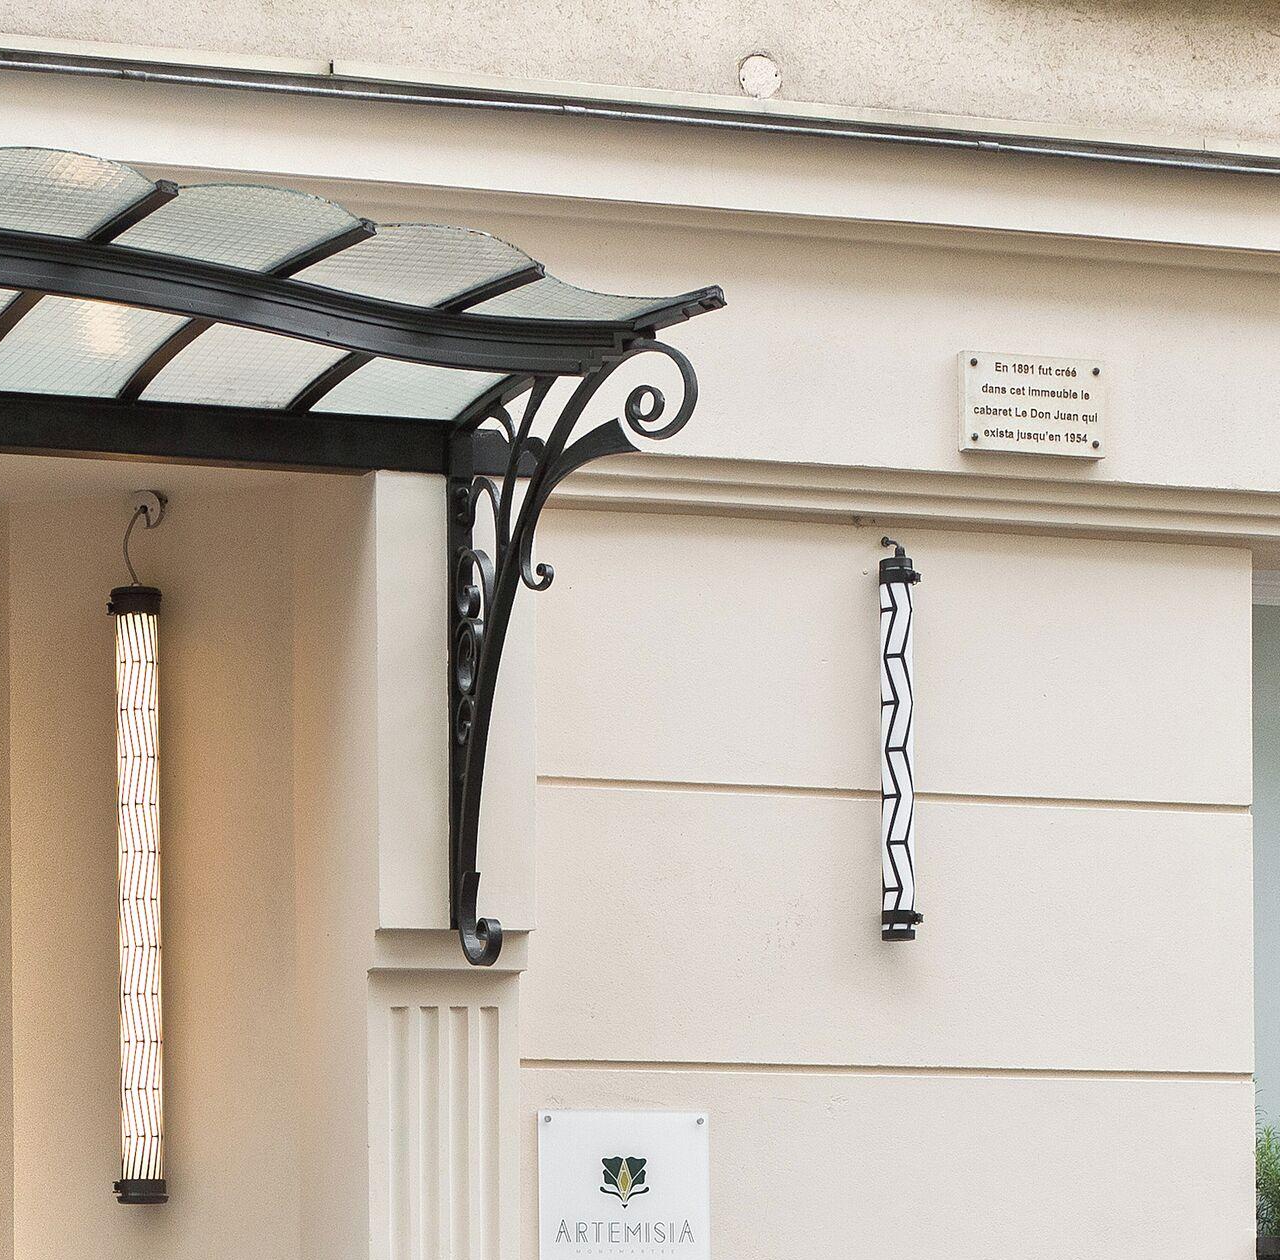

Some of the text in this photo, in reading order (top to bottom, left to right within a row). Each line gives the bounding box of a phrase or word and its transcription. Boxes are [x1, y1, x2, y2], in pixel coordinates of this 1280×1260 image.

[995, 362, 1077, 378] En 1891 fut créé
[982, 383, 1090, 400] dans cet immeuble le
[974, 406, 1098, 424] cabaret Le Don Juan qui
[984, 428, 1088, 443] exista jusqu'en 1954
[555, 1219, 695, 1243] ARTEMISIA
